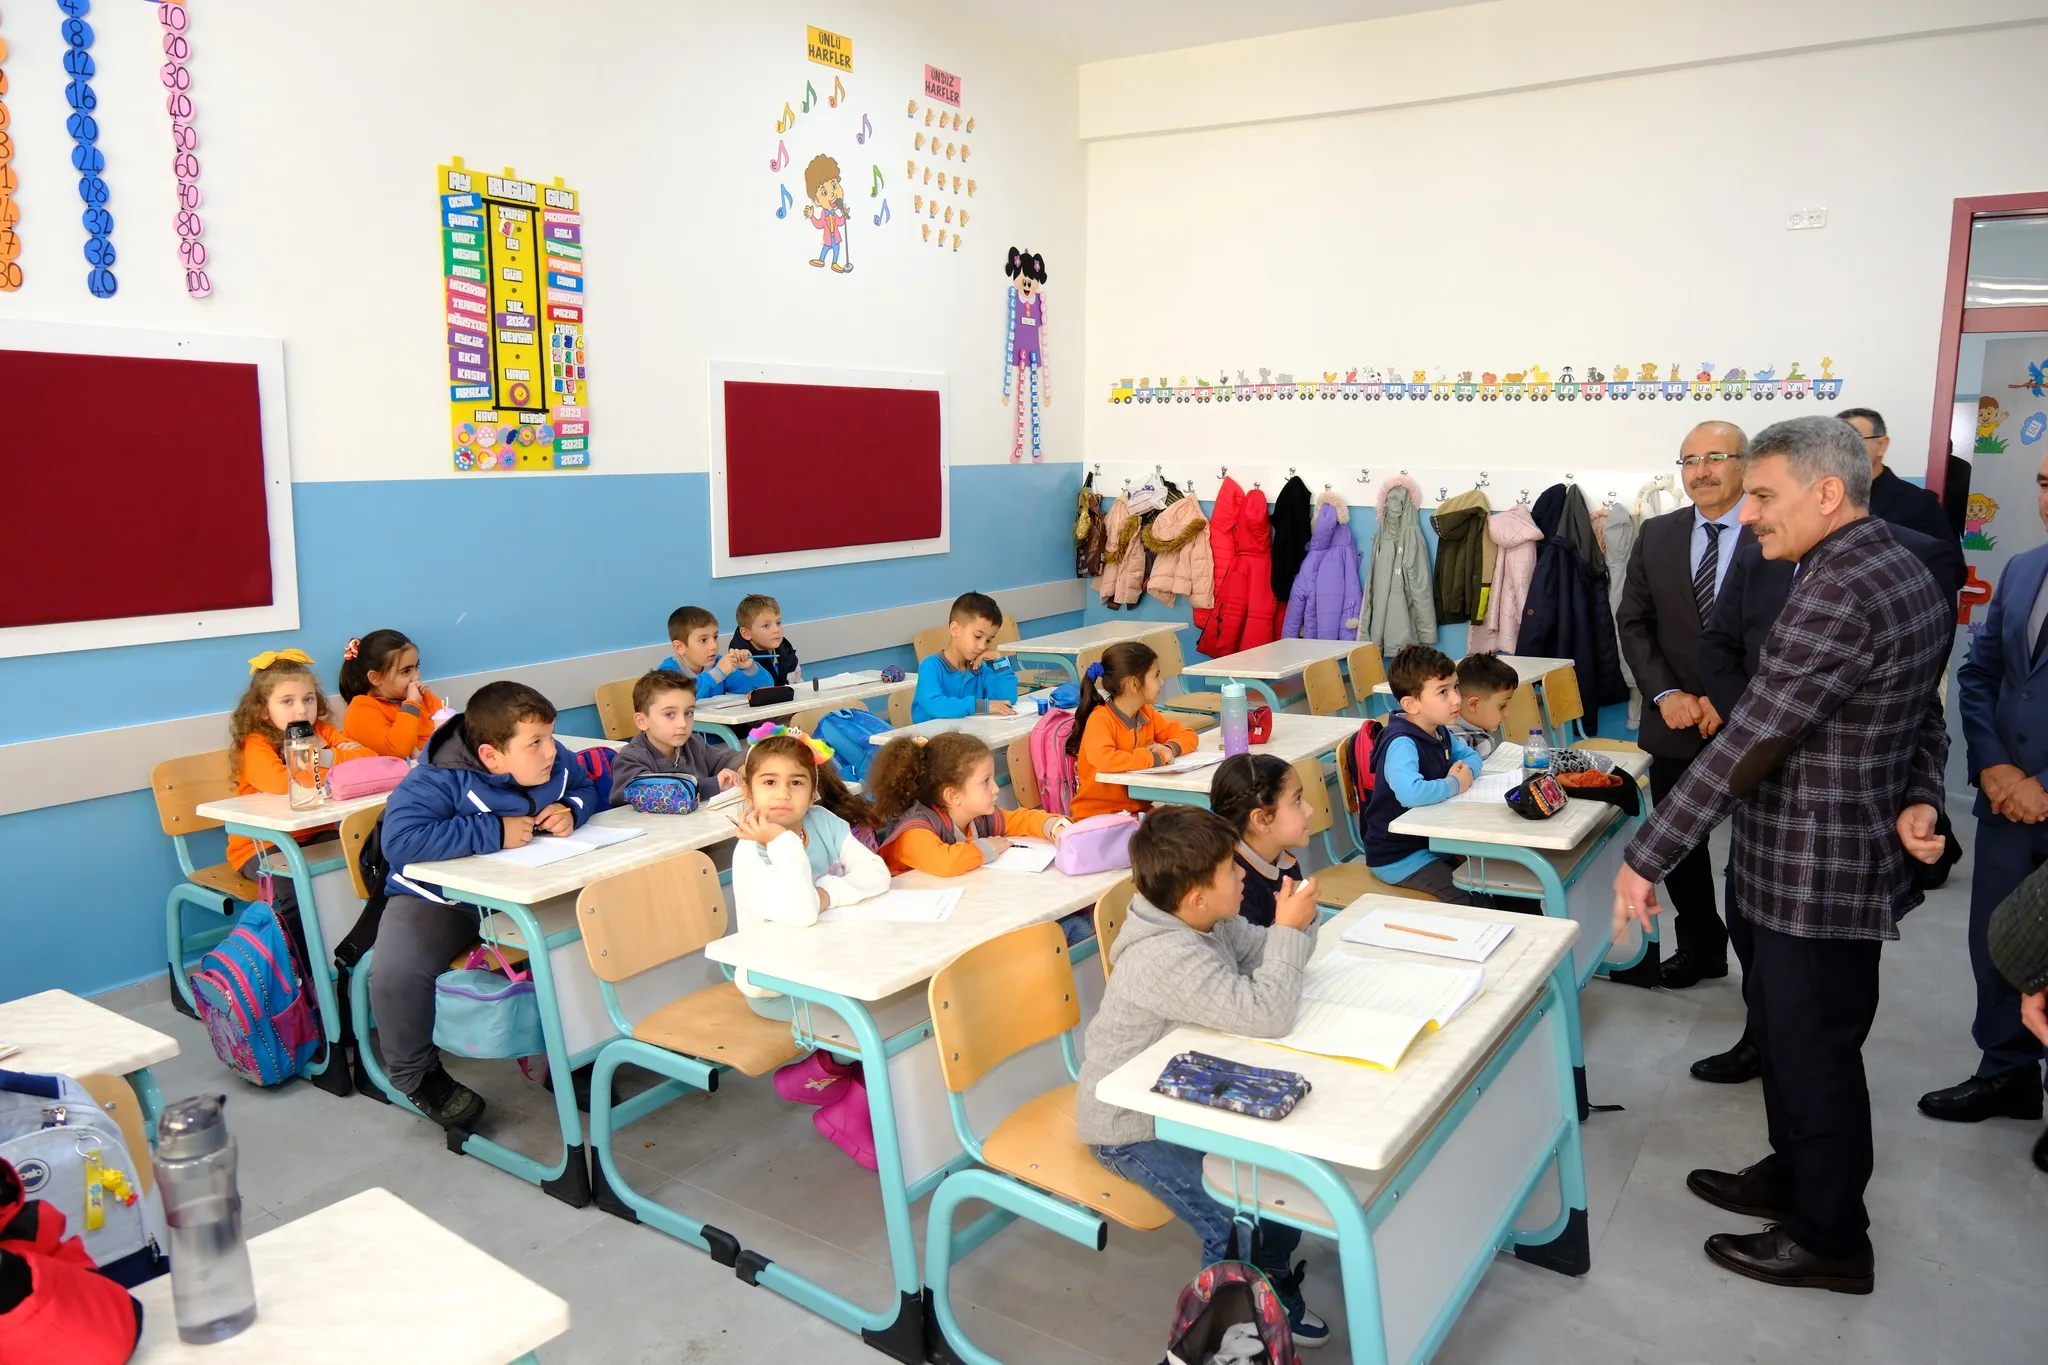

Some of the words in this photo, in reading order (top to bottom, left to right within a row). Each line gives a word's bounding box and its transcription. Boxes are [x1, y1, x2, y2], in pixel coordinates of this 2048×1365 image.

[161, 4, 187, 31] 10
[69, 20, 84, 48] 8
[165, 32, 188, 59] 20
[819, 31, 841, 50] ÜNLÜ
[67, 50, 93, 76] 12
[808, 44, 851, 68] HARFLER
[162, 63, 190, 91] 30
[931, 69, 954, 88] ÜNSÜZ
[68, 81, 96, 110] 16
[925, 80, 960, 105] HARFLER
[169, 94, 192, 119] 40
[70, 113, 97, 140] 20
[172, 124, 197, 150] 50
[75, 145, 100, 174] 24
[174, 153, 199, 178] 60
[81, 177, 107, 204] 28
[179, 183, 199, 208] 70
[87, 209, 112, 235] 32
[176, 211, 201, 237] 80
[91, 237, 116, 267] 36
[180, 241, 206, 266] 90
[92, 269, 117, 297] 40
[186, 271, 210, 292] 100
[506, 315, 531, 328] 2024
